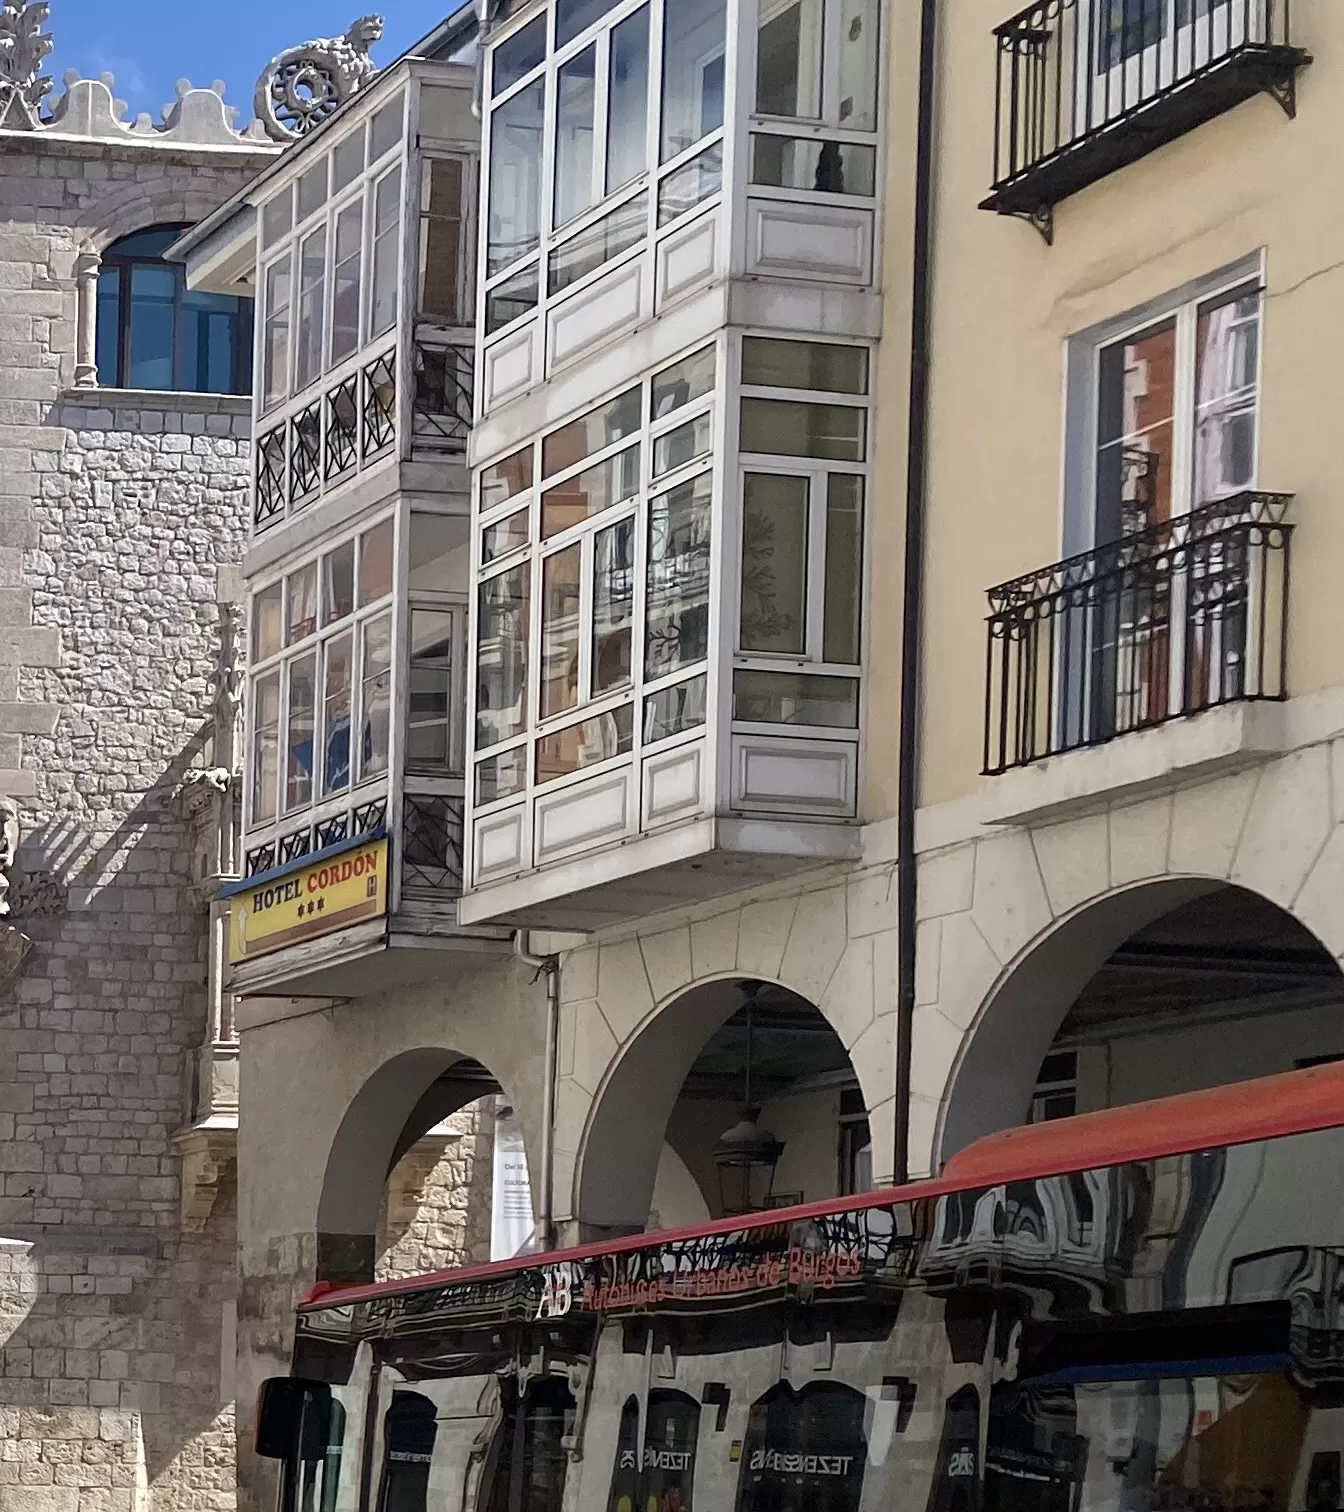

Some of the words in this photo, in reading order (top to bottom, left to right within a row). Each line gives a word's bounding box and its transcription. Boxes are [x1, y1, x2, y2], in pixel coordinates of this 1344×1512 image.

[252, 878, 304, 913] HOTEL
[306, 850, 379, 894] CORDÓN
[788, 1247, 862, 1289] Burgos
